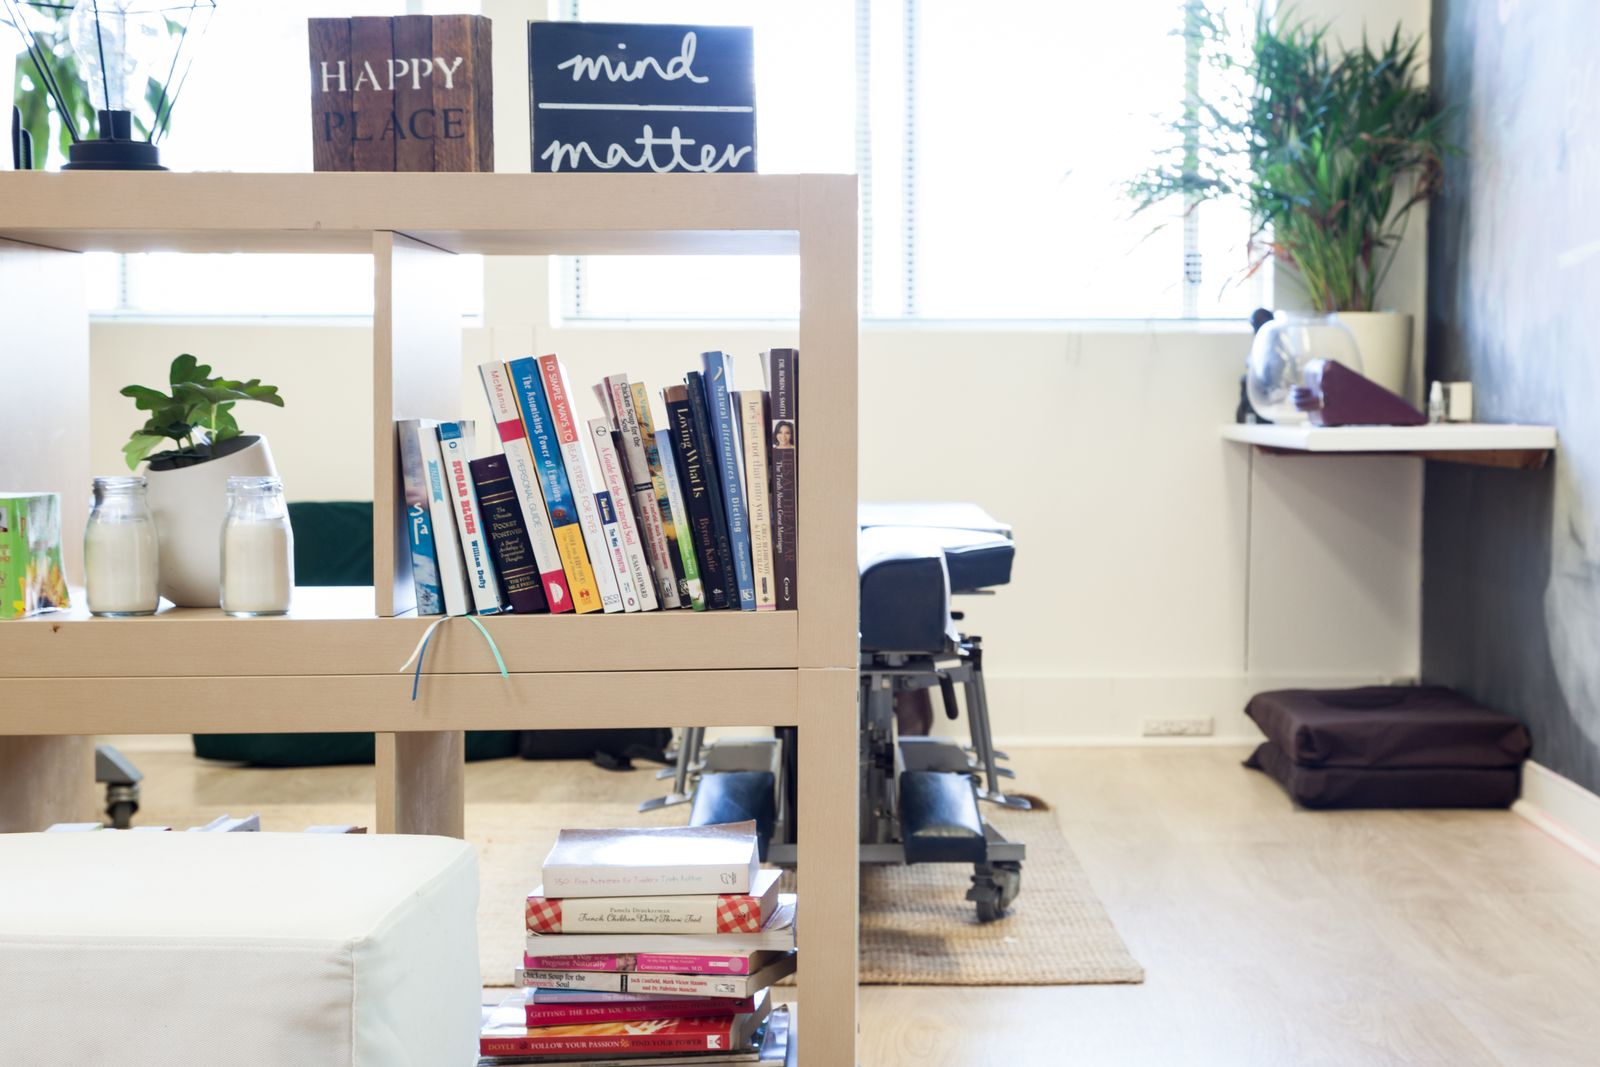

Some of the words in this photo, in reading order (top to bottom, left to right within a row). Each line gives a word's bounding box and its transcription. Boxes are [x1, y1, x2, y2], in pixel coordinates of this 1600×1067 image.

[558, 32, 709, 83] mind
[321, 57, 463, 93] HAPPY
[323, 107, 466, 143] PLACE
[541, 124, 753, 173] matter
[544, 358, 555, 371] 10
[521, 375, 534, 390] The
[547, 372, 563, 401] SIMPLE
[619, 381, 632, 406] Chicken
[715, 384, 728, 418] Natural
[523, 390, 546, 435] Astonishing
[555, 402, 570, 427] WAYS
[624, 407, 636, 425] Soup
[620, 417, 629, 433] Soul
[629, 424, 639, 436] for
[676, 406, 695, 448] Loving
[747, 421, 758, 439] just
[537, 434, 552, 457] Power
[562, 428, 574, 443] TO
[632, 436, 641, 446] the
[566, 443, 579, 463] BEAT
[720, 422, 736, 478] alternatives
[751, 441, 760, 456] not
[544, 458, 555, 468] of
[602, 452, 615, 473] Guide
[685, 449, 701, 483] What
[752, 459, 761, 479] that
[451, 459, 468, 497] SUGAR
[546, 467, 564, 503] Emotions
[571, 464, 587, 494] STRESS
[608, 473, 618, 484] for
[729, 483, 738, 492] to
[611, 484, 621, 495] the
[692, 485, 704, 498] Is
[754, 482, 763, 500] into
[579, 495, 591, 512] FOR
[614, 496, 630, 528] Advanced
[754, 503, 763, 520] you
[460, 499, 476, 534] BLUES
[527, 501, 542, 528] GUIDE
[584, 513, 598, 535] EVER
[728, 496, 743, 533] Dieting
[623, 528, 635, 545] Soul
[697, 516, 712, 545] Byron
[470, 538, 482, 567] William
[704, 546, 718, 572] Katie
[475, 569, 486, 589] Dufty
[572, 960, 607, 969] Naturally
[548, 972, 564, 981] Soup
[564, 973, 574, 981] for
[530, 1010, 566, 1018] GETTING
[488, 1043, 515, 1051] DOYLE
